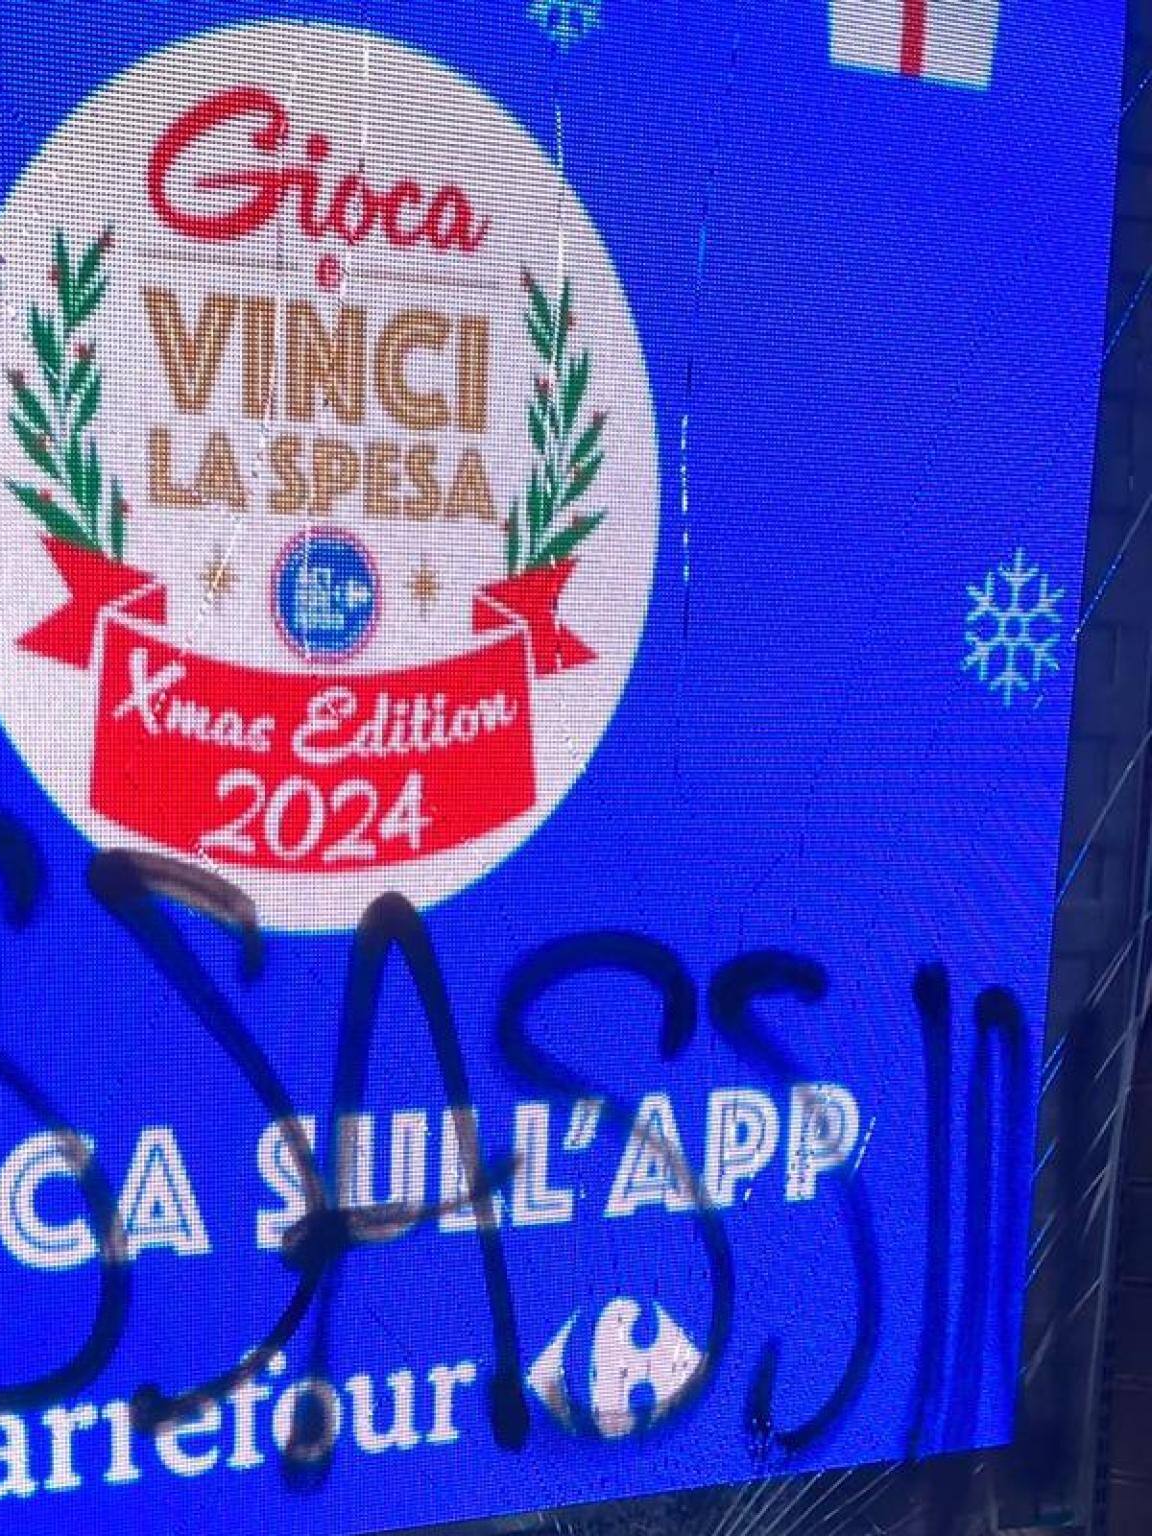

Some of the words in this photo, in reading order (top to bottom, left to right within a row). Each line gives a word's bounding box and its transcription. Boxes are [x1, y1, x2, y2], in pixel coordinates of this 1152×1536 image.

[147, 86, 491, 252] Gioca
[138, 286, 491, 435] VINCI
[149, 426, 248, 511] LA
[267, 437, 499, 522] SPESA
[112, 646, 276, 754] Xmas
[292, 684, 517, 764] Edition
[198, 770, 432, 862] 2024
[255, 1082, 861, 1250] SULL'APP
